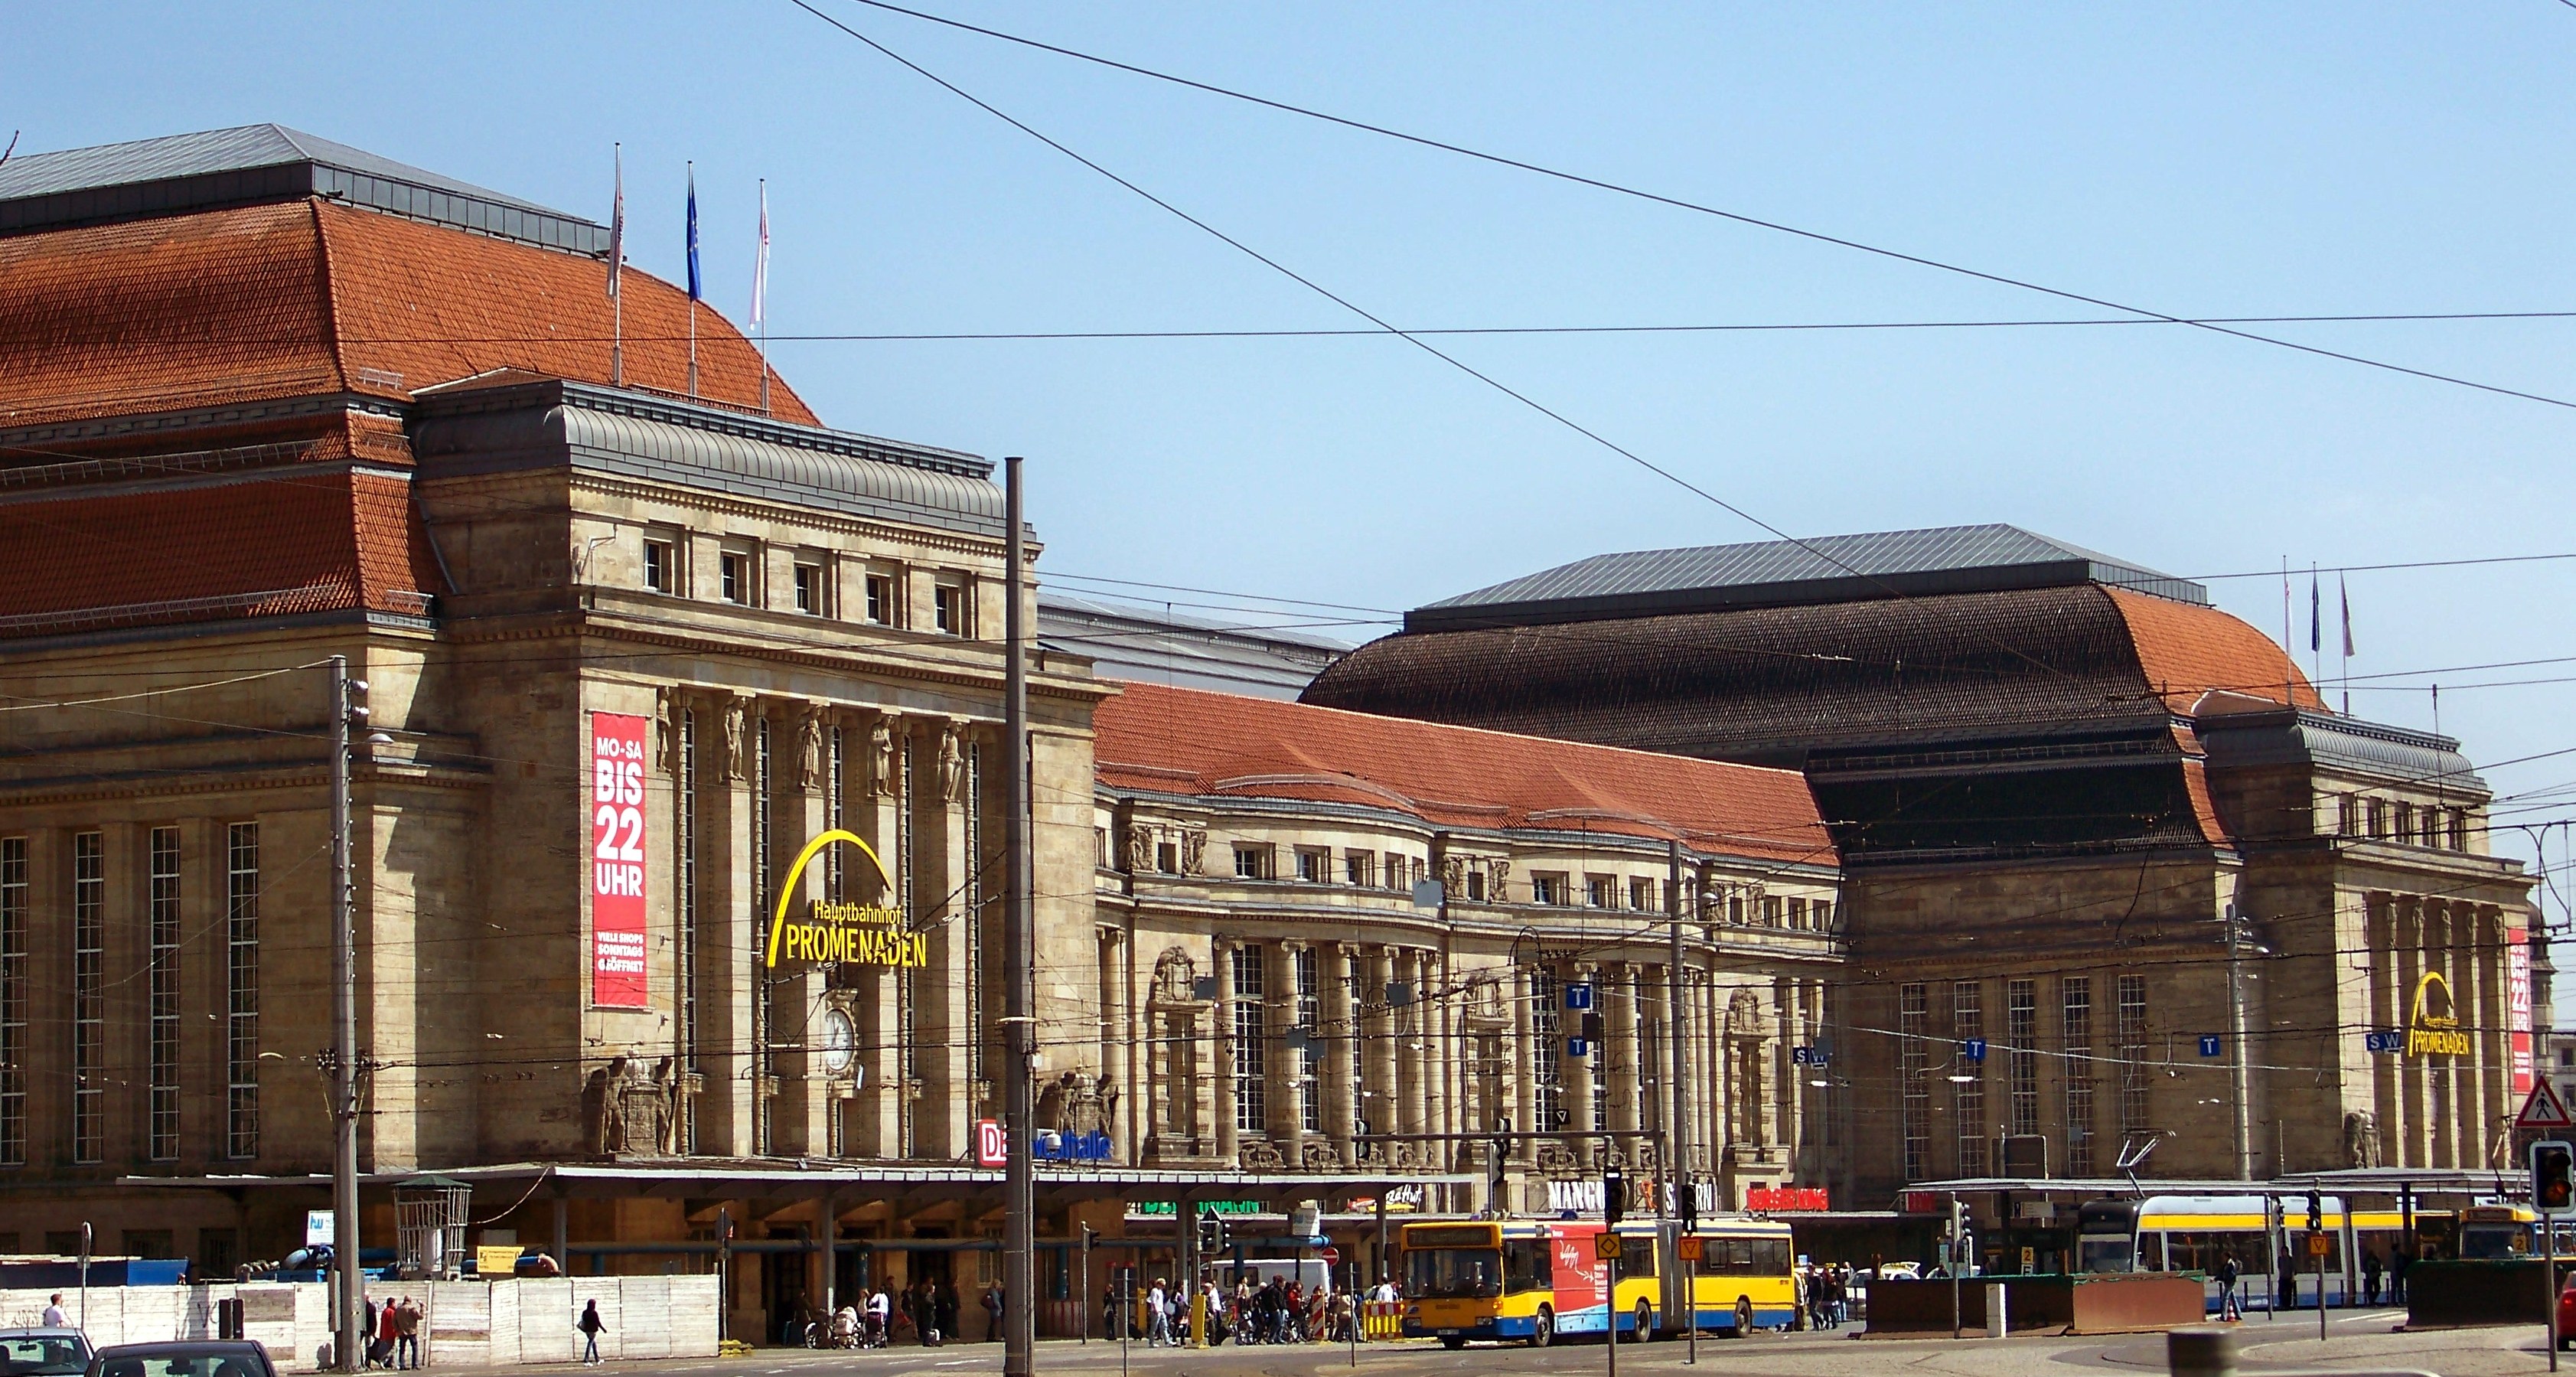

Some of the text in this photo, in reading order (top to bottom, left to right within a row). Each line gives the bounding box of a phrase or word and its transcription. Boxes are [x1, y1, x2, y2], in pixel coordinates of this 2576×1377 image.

[596, 736, 643, 760] MO-SA
[596, 759, 643, 806] BIS
[596, 804, 643, 862] 22
[596, 862, 643, 897] UHR
[814, 899, 902, 925] Hauptbahnhof
[618, 932, 644, 945] SHOPS
[786, 924, 927, 967] PROMENADEN
[597, 943, 644, 958] SONNTAGS
[597, 956, 644, 972] GEÖFFNET
[1572, 988, 1585, 1006] T
[2511, 980, 2527, 1012] 22
[1573, 1039, 1583, 1054] T
[1971, 1041, 1982, 1056] T
[2369, 1034, 2399, 1048] S W
[2415, 1029, 2469, 1055] PROMENADEN
[1797, 1049, 1805, 1062] S
[1547, 1181, 1605, 1209] MANGO
[2024, 1250, 2031, 1261] 2
